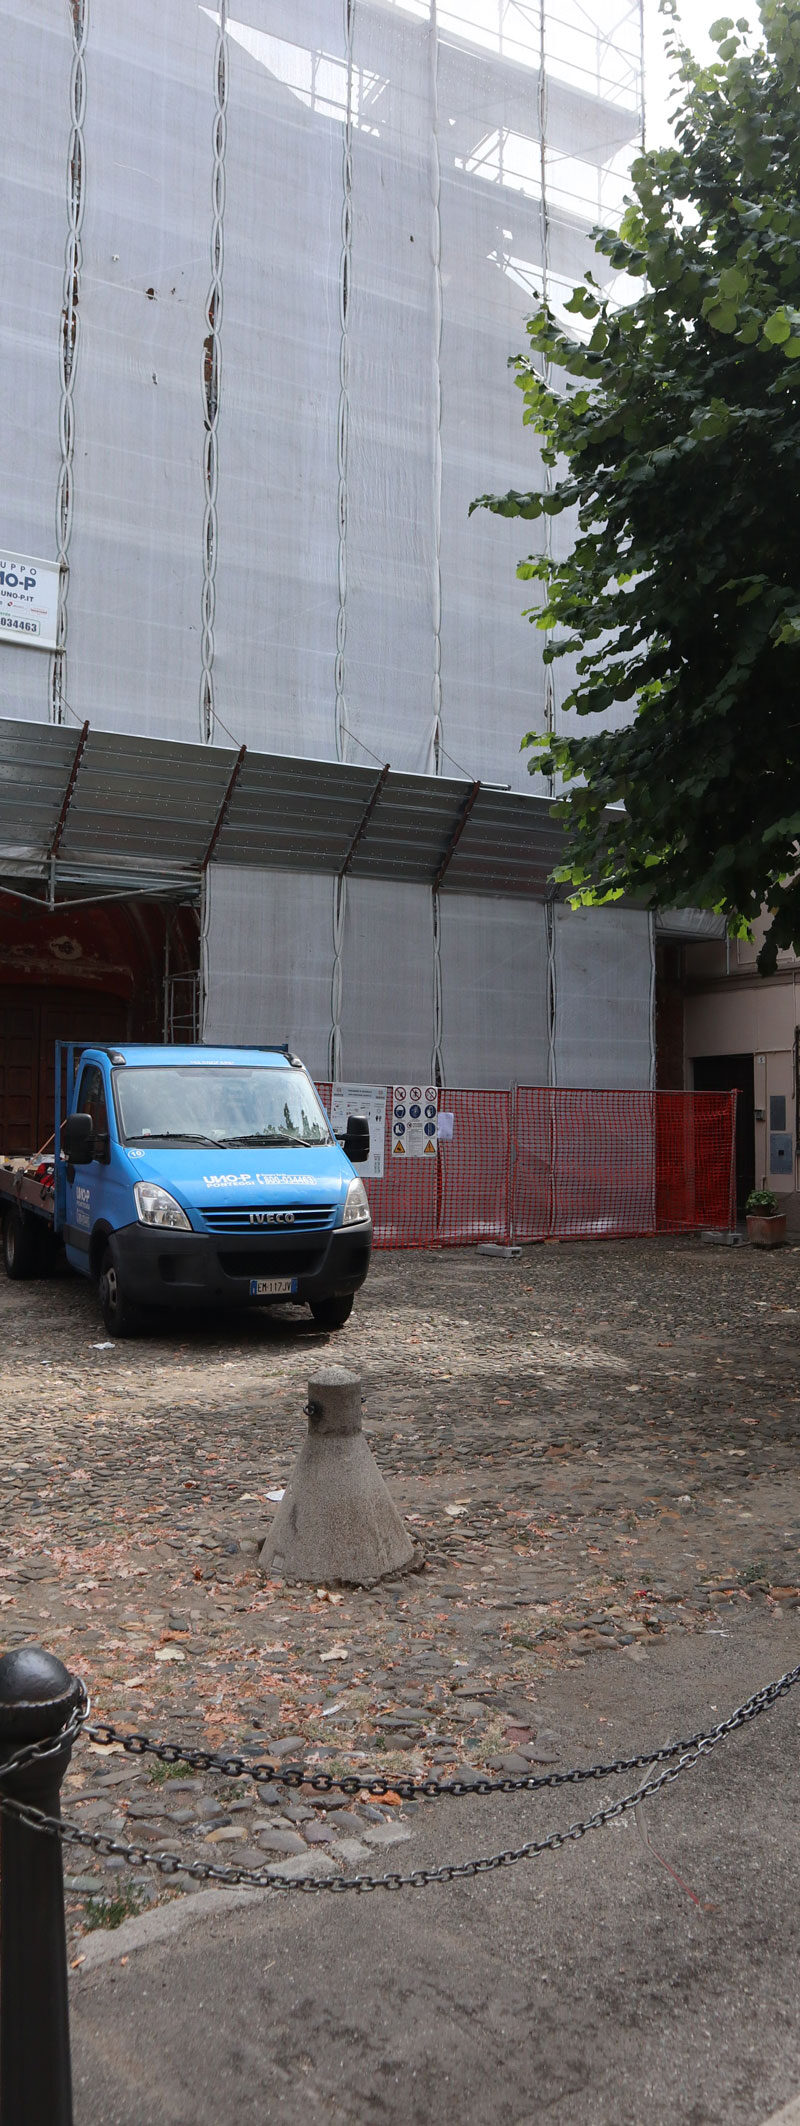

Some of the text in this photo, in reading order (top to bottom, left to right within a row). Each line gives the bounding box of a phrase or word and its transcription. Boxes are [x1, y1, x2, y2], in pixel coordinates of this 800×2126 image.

[0, 617, 37, 633] 034463
[203, 1173, 252, 1184] UNO-P
[249, 1213, 295, 1224] IVECO
